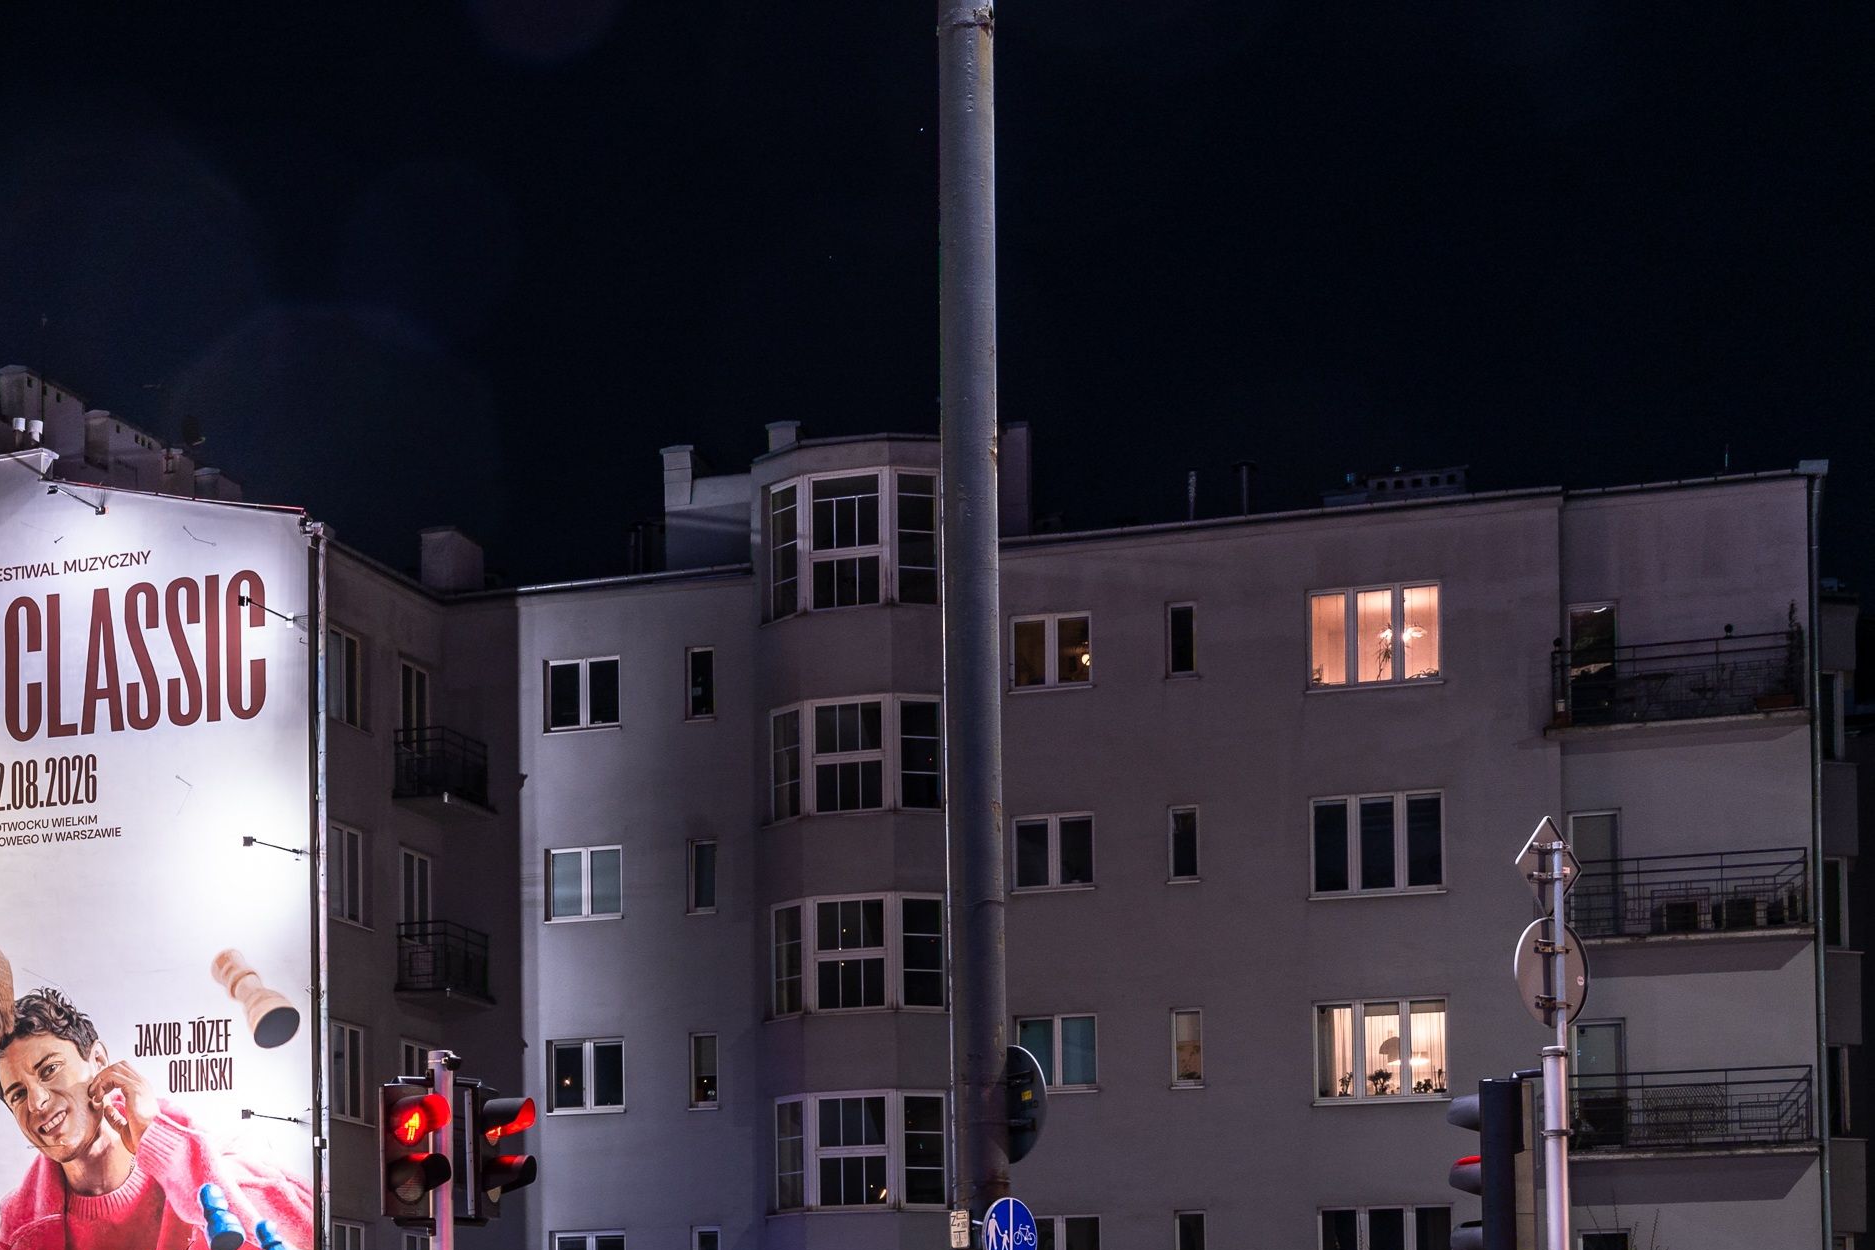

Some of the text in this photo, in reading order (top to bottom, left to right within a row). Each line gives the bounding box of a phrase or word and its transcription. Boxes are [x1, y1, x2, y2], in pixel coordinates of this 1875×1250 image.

[63, 550, 151, 575] MUZYCZNY
[4, 569, 266, 742] CLASSIC
[41, 832, 53, 844] W
[54, 826, 122, 842] WARSZAWIE
[51, 814, 98, 828] WIELKIM
[134, 1015, 232, 1057] JAKUB JÓZEF
[168, 1054, 233, 1093] ORLIŃSKI
